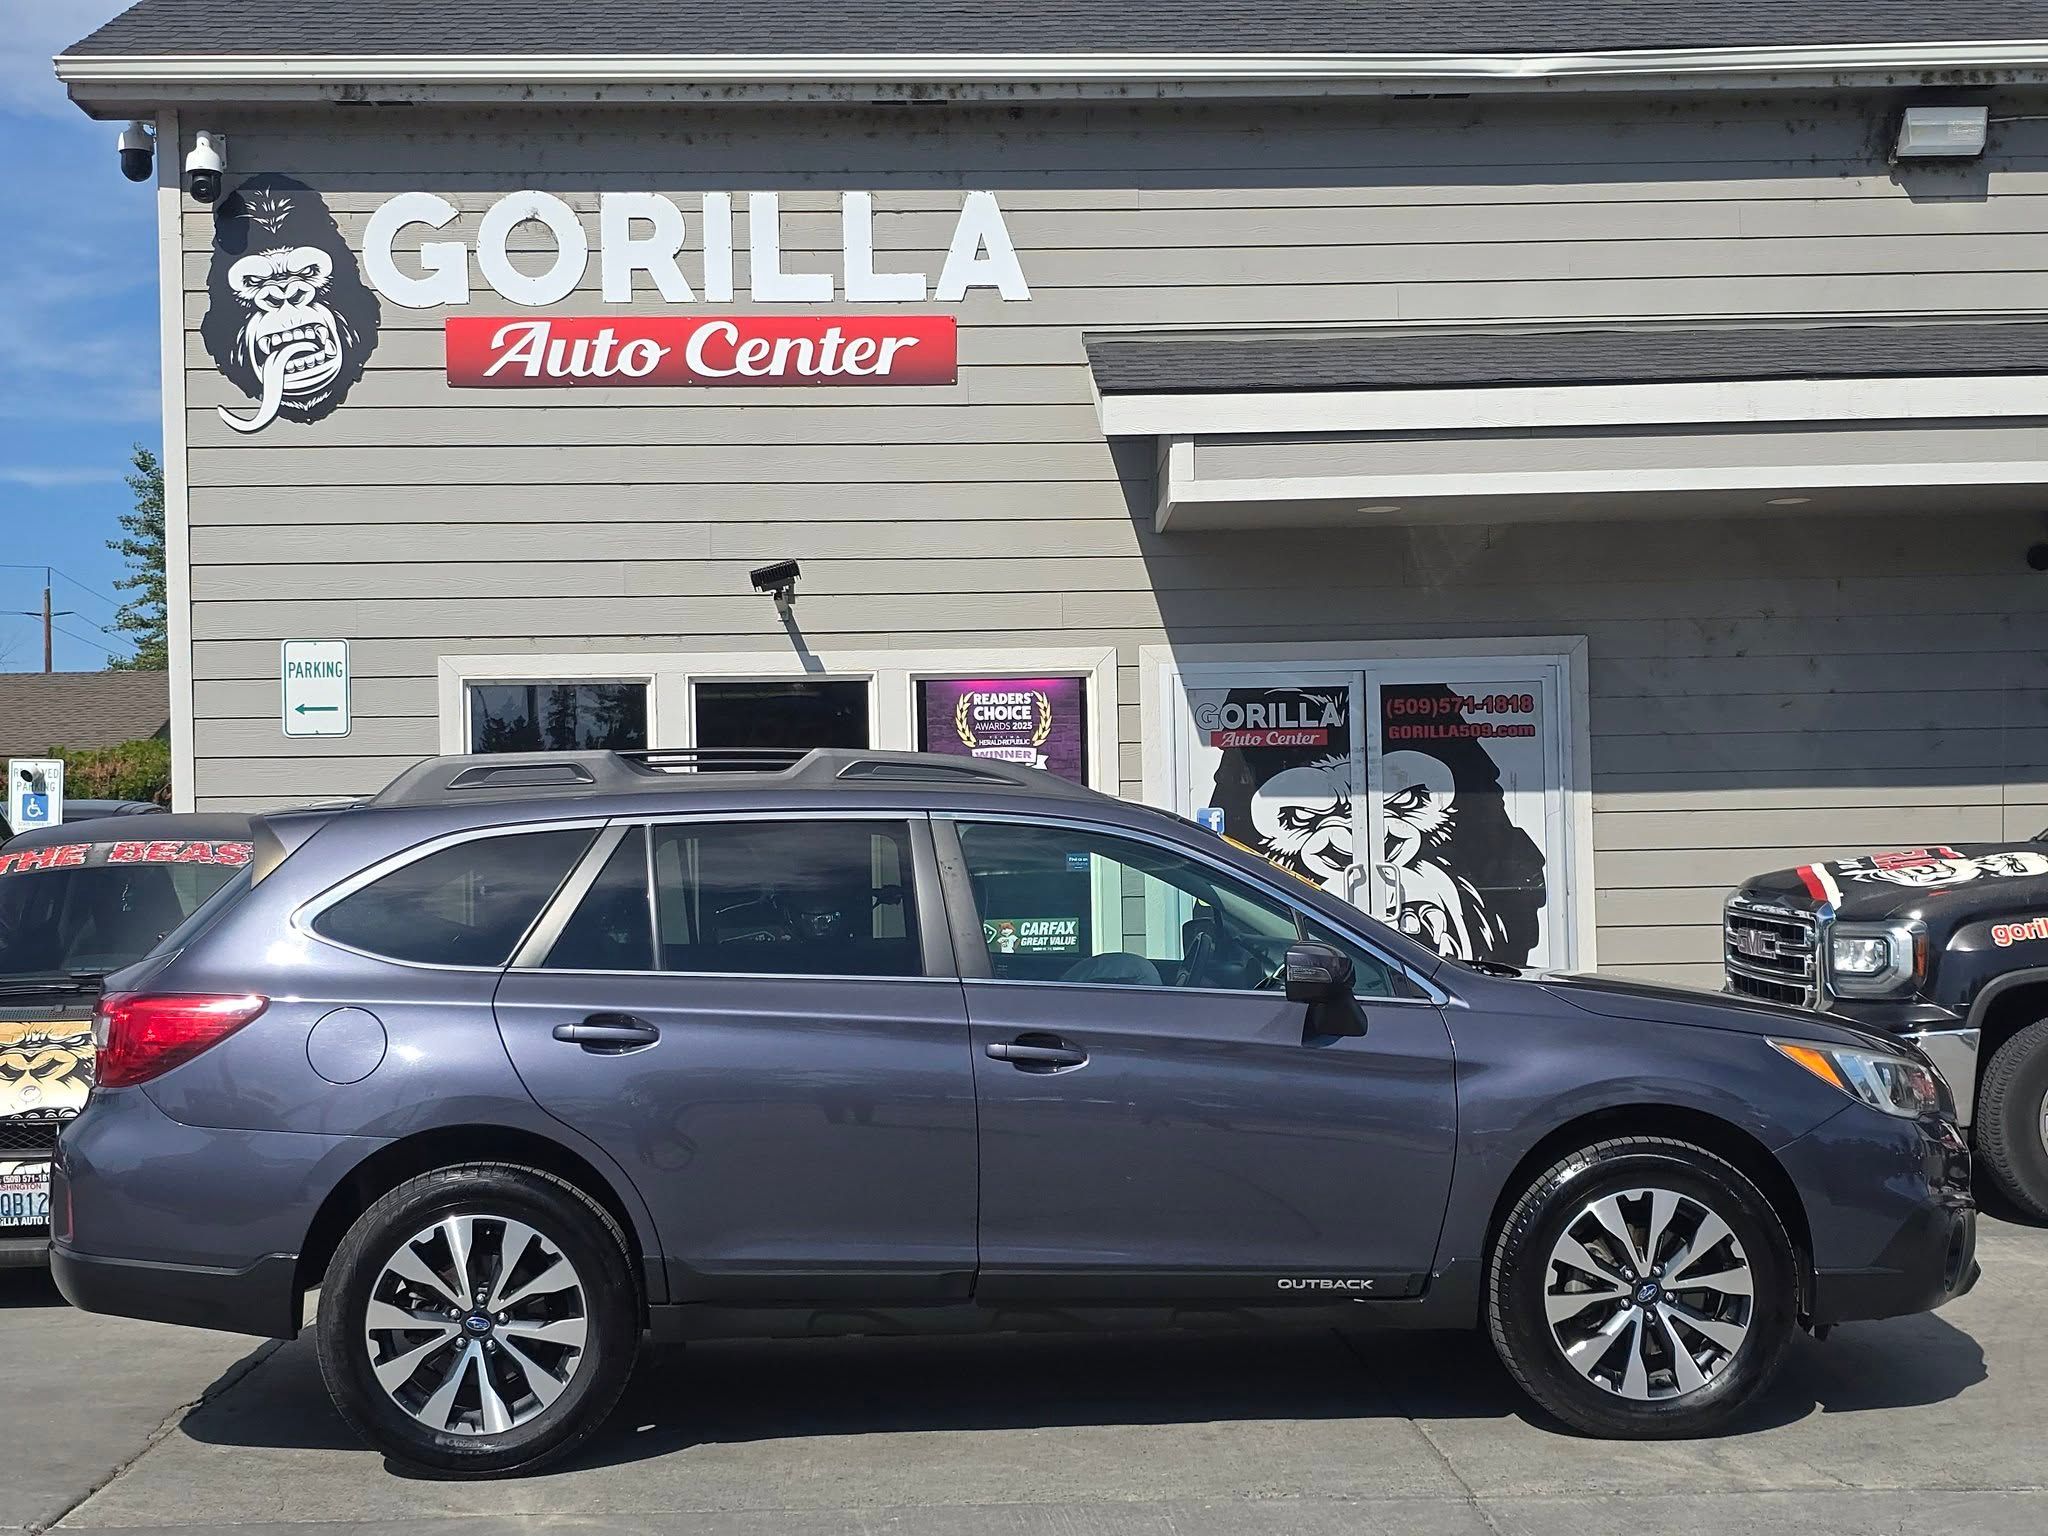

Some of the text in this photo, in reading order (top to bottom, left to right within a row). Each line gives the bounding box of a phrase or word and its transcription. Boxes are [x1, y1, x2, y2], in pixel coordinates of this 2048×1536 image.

[362, 189, 1031, 308] GORILLA
[483, 320, 919, 378] Auto Center
[288, 661, 343, 678] PARKING
[973, 705, 1032, 720] CHOICE
[1386, 694, 1535, 719] (509)571-1818
[1194, 702, 1342, 731] GORILLA
[974, 721, 1033, 731] AWARDS 2025
[1388, 723, 1536, 739] GORILLA509.com
[1220, 731, 1320, 747] Auto Center
[974, 750, 1032, 759] WINNER
[0, 843, 92, 875] THE
[1020, 921, 1076, 936] CARFAX
[1020, 936, 1077, 946] GREAT VALUE
[1737, 926, 1777, 960] GMC
[21, 1216, 43, 1225] AUTO
[1277, 1279, 1374, 1289] OUTBACK
